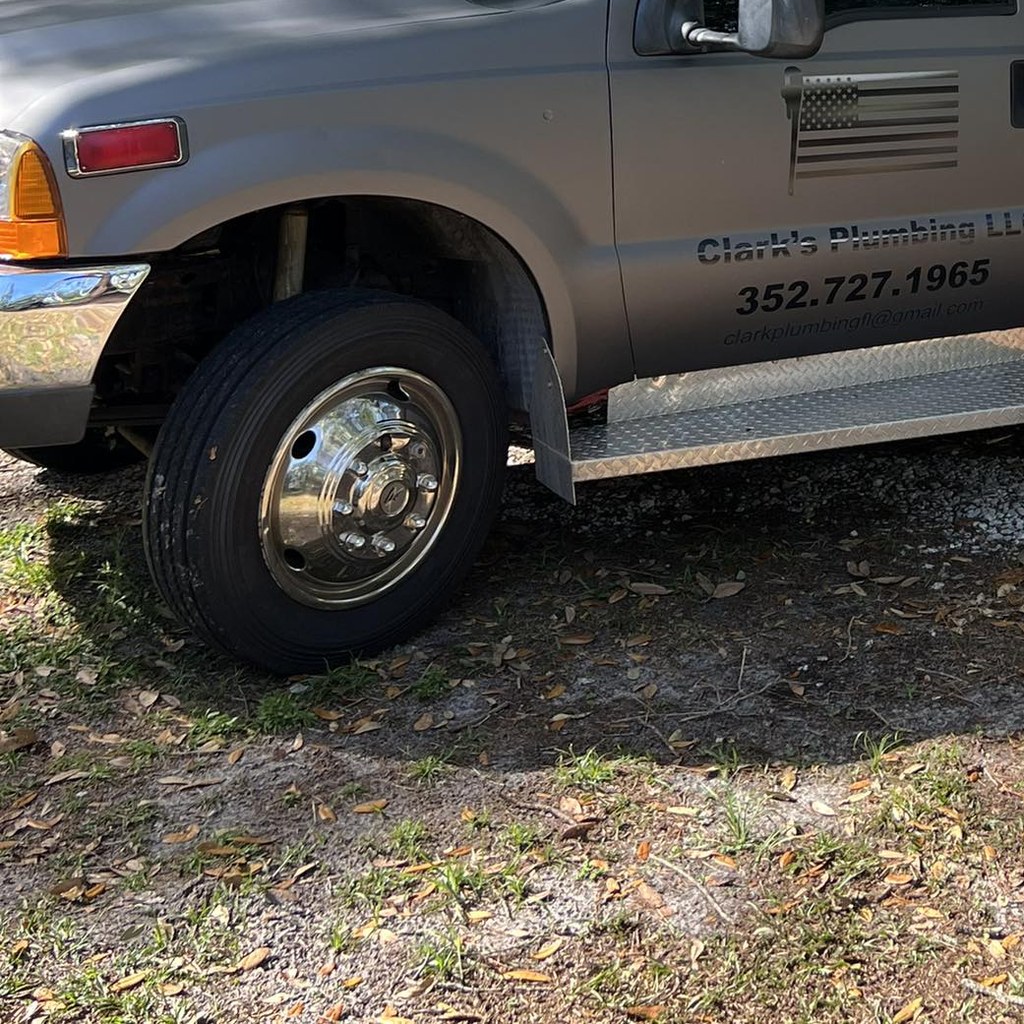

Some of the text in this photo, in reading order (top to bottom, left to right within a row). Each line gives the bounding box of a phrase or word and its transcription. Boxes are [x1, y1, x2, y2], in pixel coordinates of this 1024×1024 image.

[697, 230, 818, 266] Clark's
[829, 218, 976, 253] Plumbing
[735, 258, 991, 316] 352.727.1965
